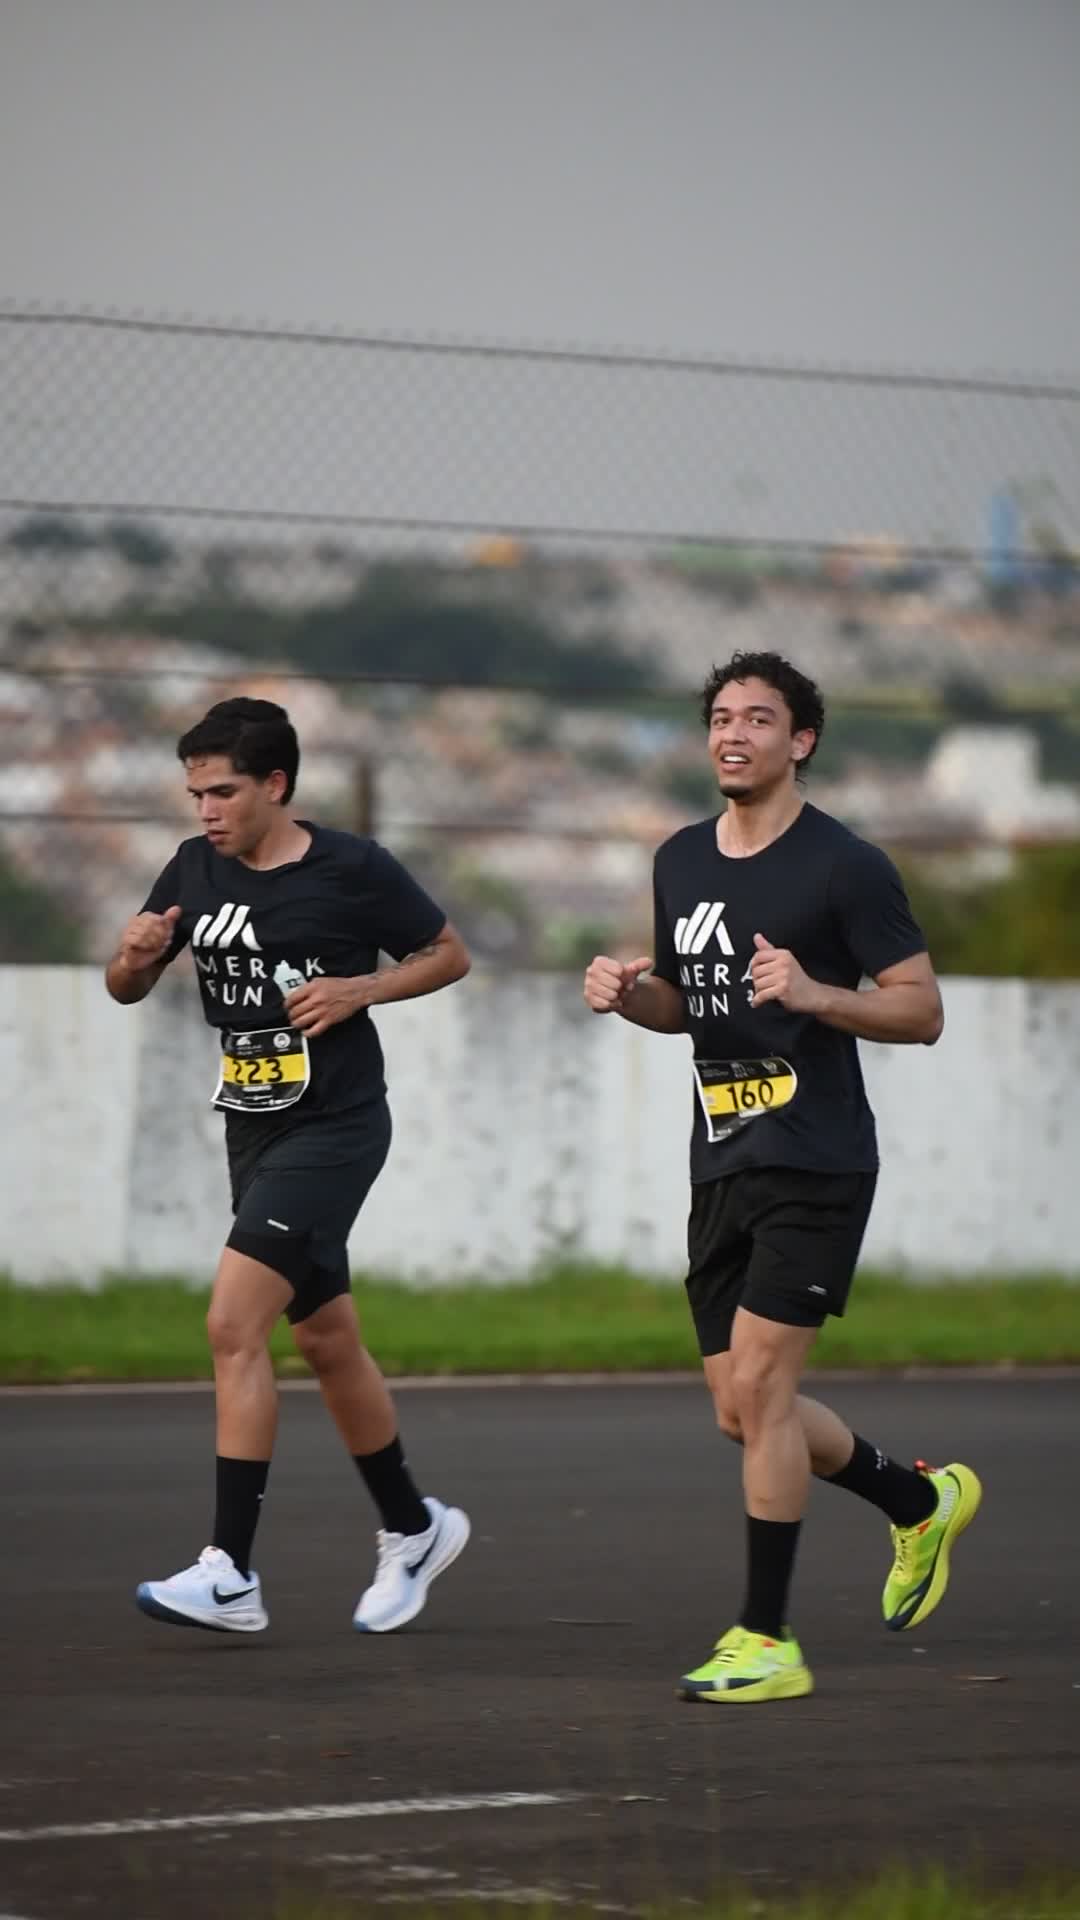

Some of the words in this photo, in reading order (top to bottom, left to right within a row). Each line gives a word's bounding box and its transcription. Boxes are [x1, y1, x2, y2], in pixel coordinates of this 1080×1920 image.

[193, 955, 326, 979] MERK
[232, 1059, 283, 1084] 223
[726, 1079, 774, 1111] 160
